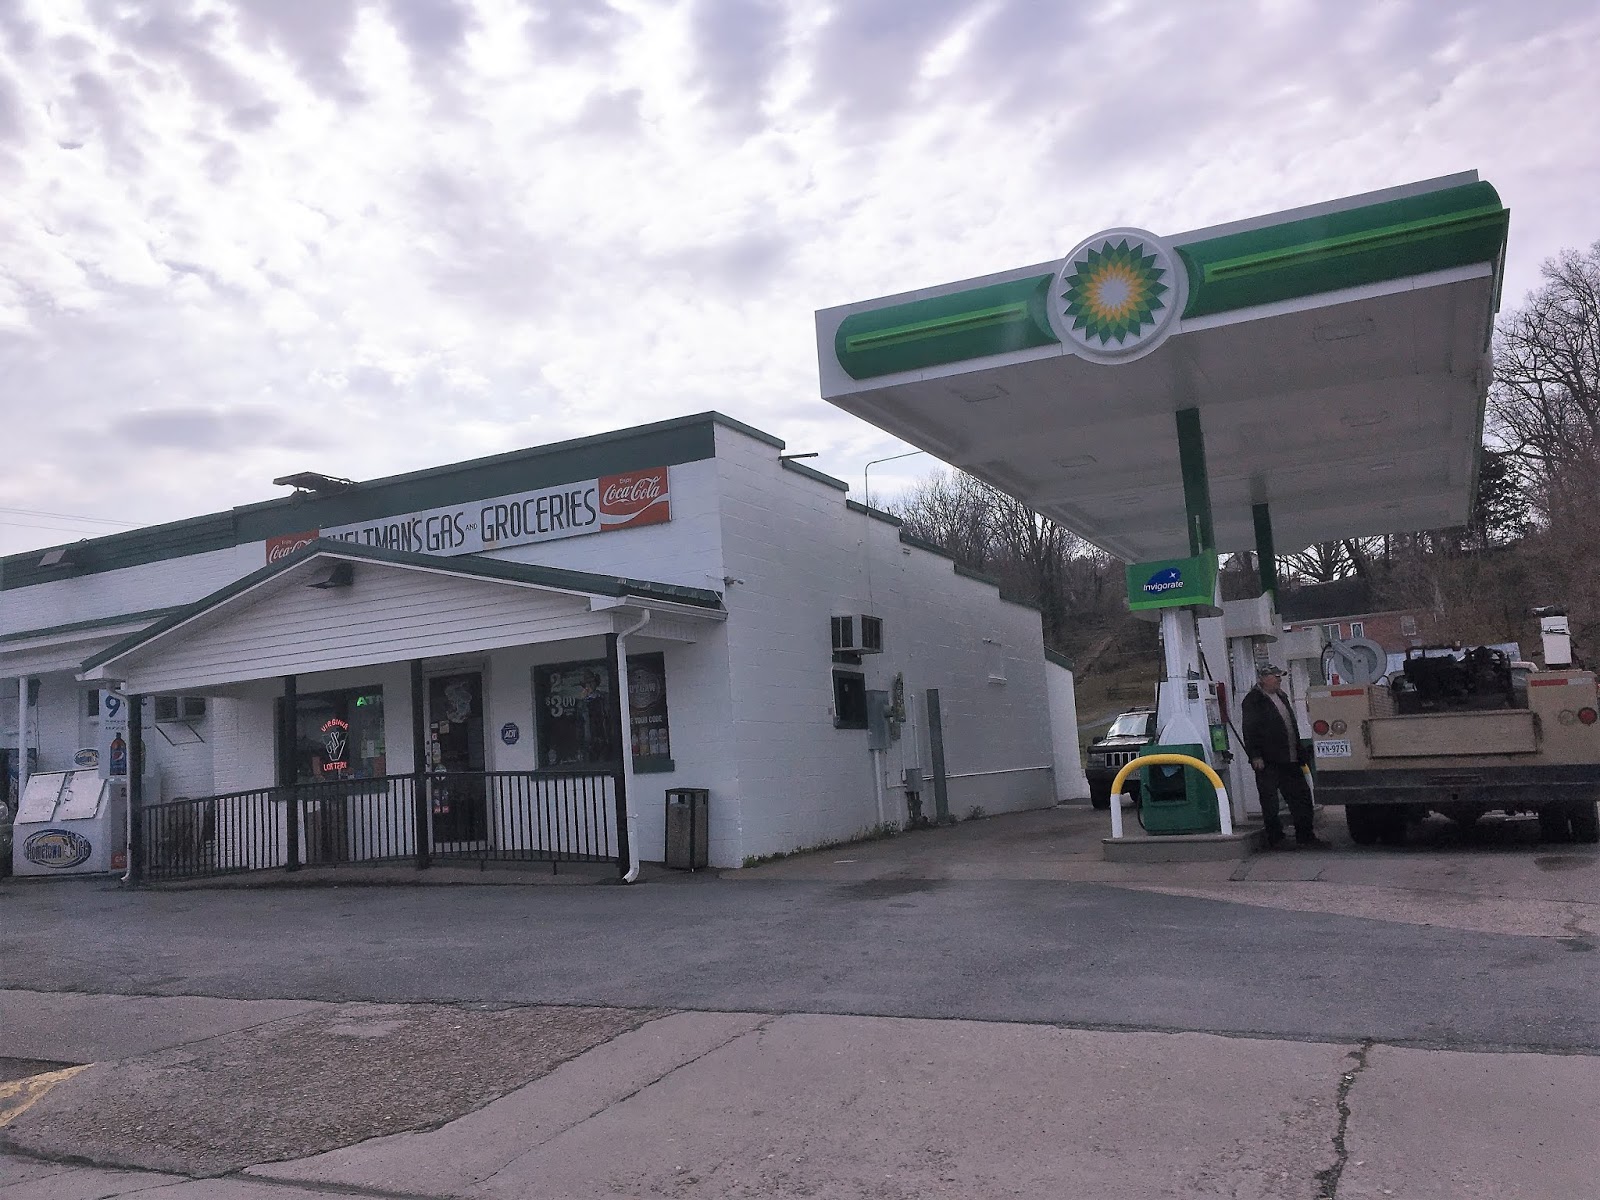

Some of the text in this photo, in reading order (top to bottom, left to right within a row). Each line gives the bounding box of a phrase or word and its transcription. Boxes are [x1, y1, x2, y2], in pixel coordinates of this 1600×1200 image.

[602, 476, 662, 506] Coca-Cola
[425, 512, 465, 551] GAS
[465, 523, 478, 531] AND
[480, 488, 597, 543] GROCERIES
[1143, 580, 1184, 592] Invigorate
[321, 719, 348, 732] VIRGINIA
[505, 730, 516, 739] ADT
[323, 762, 347, 771] LOTTERY
